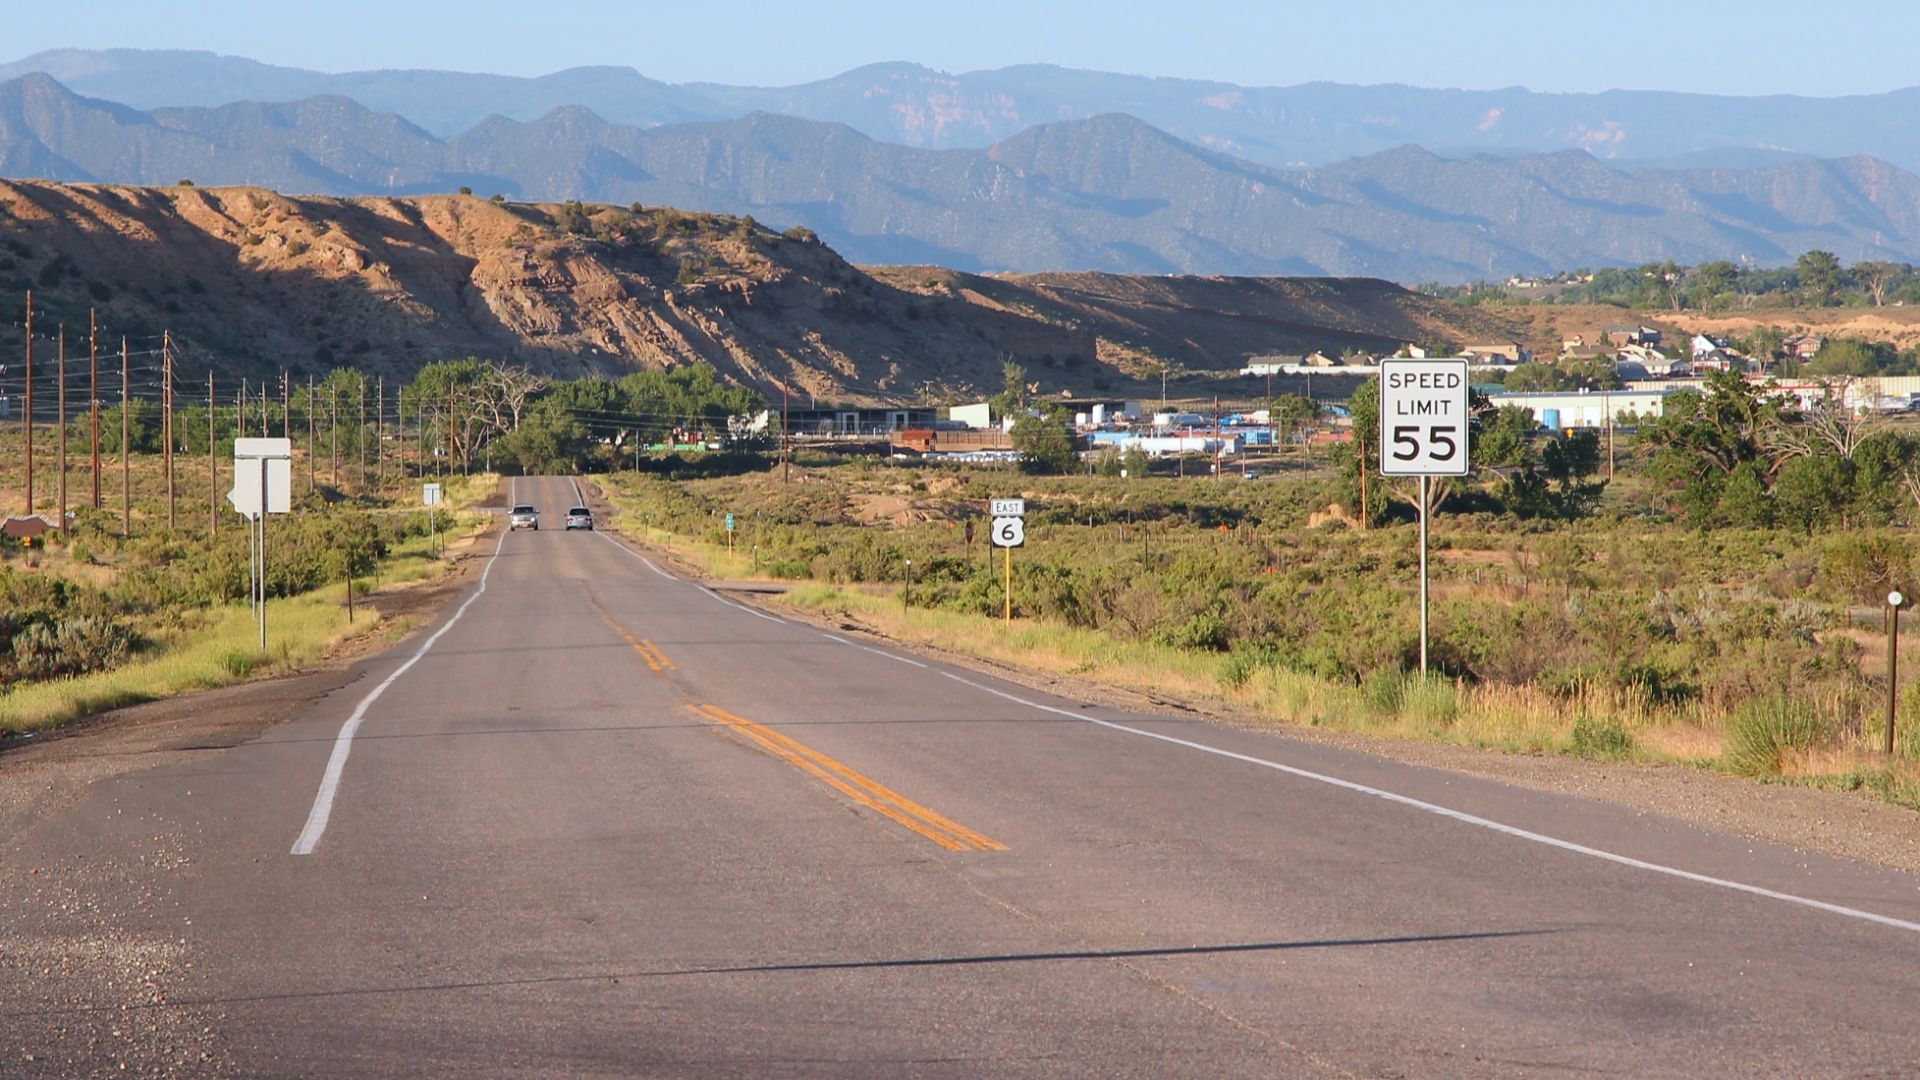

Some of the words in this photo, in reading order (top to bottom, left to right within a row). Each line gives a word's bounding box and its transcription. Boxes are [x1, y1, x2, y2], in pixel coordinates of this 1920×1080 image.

[1389, 373, 1461, 389] SPEED
[1397, 400, 1452, 415] LIMIT
[1392, 426, 1457, 461] 55
[996, 502, 1019, 512] EAST
[1001, 523, 1014, 540] 6
